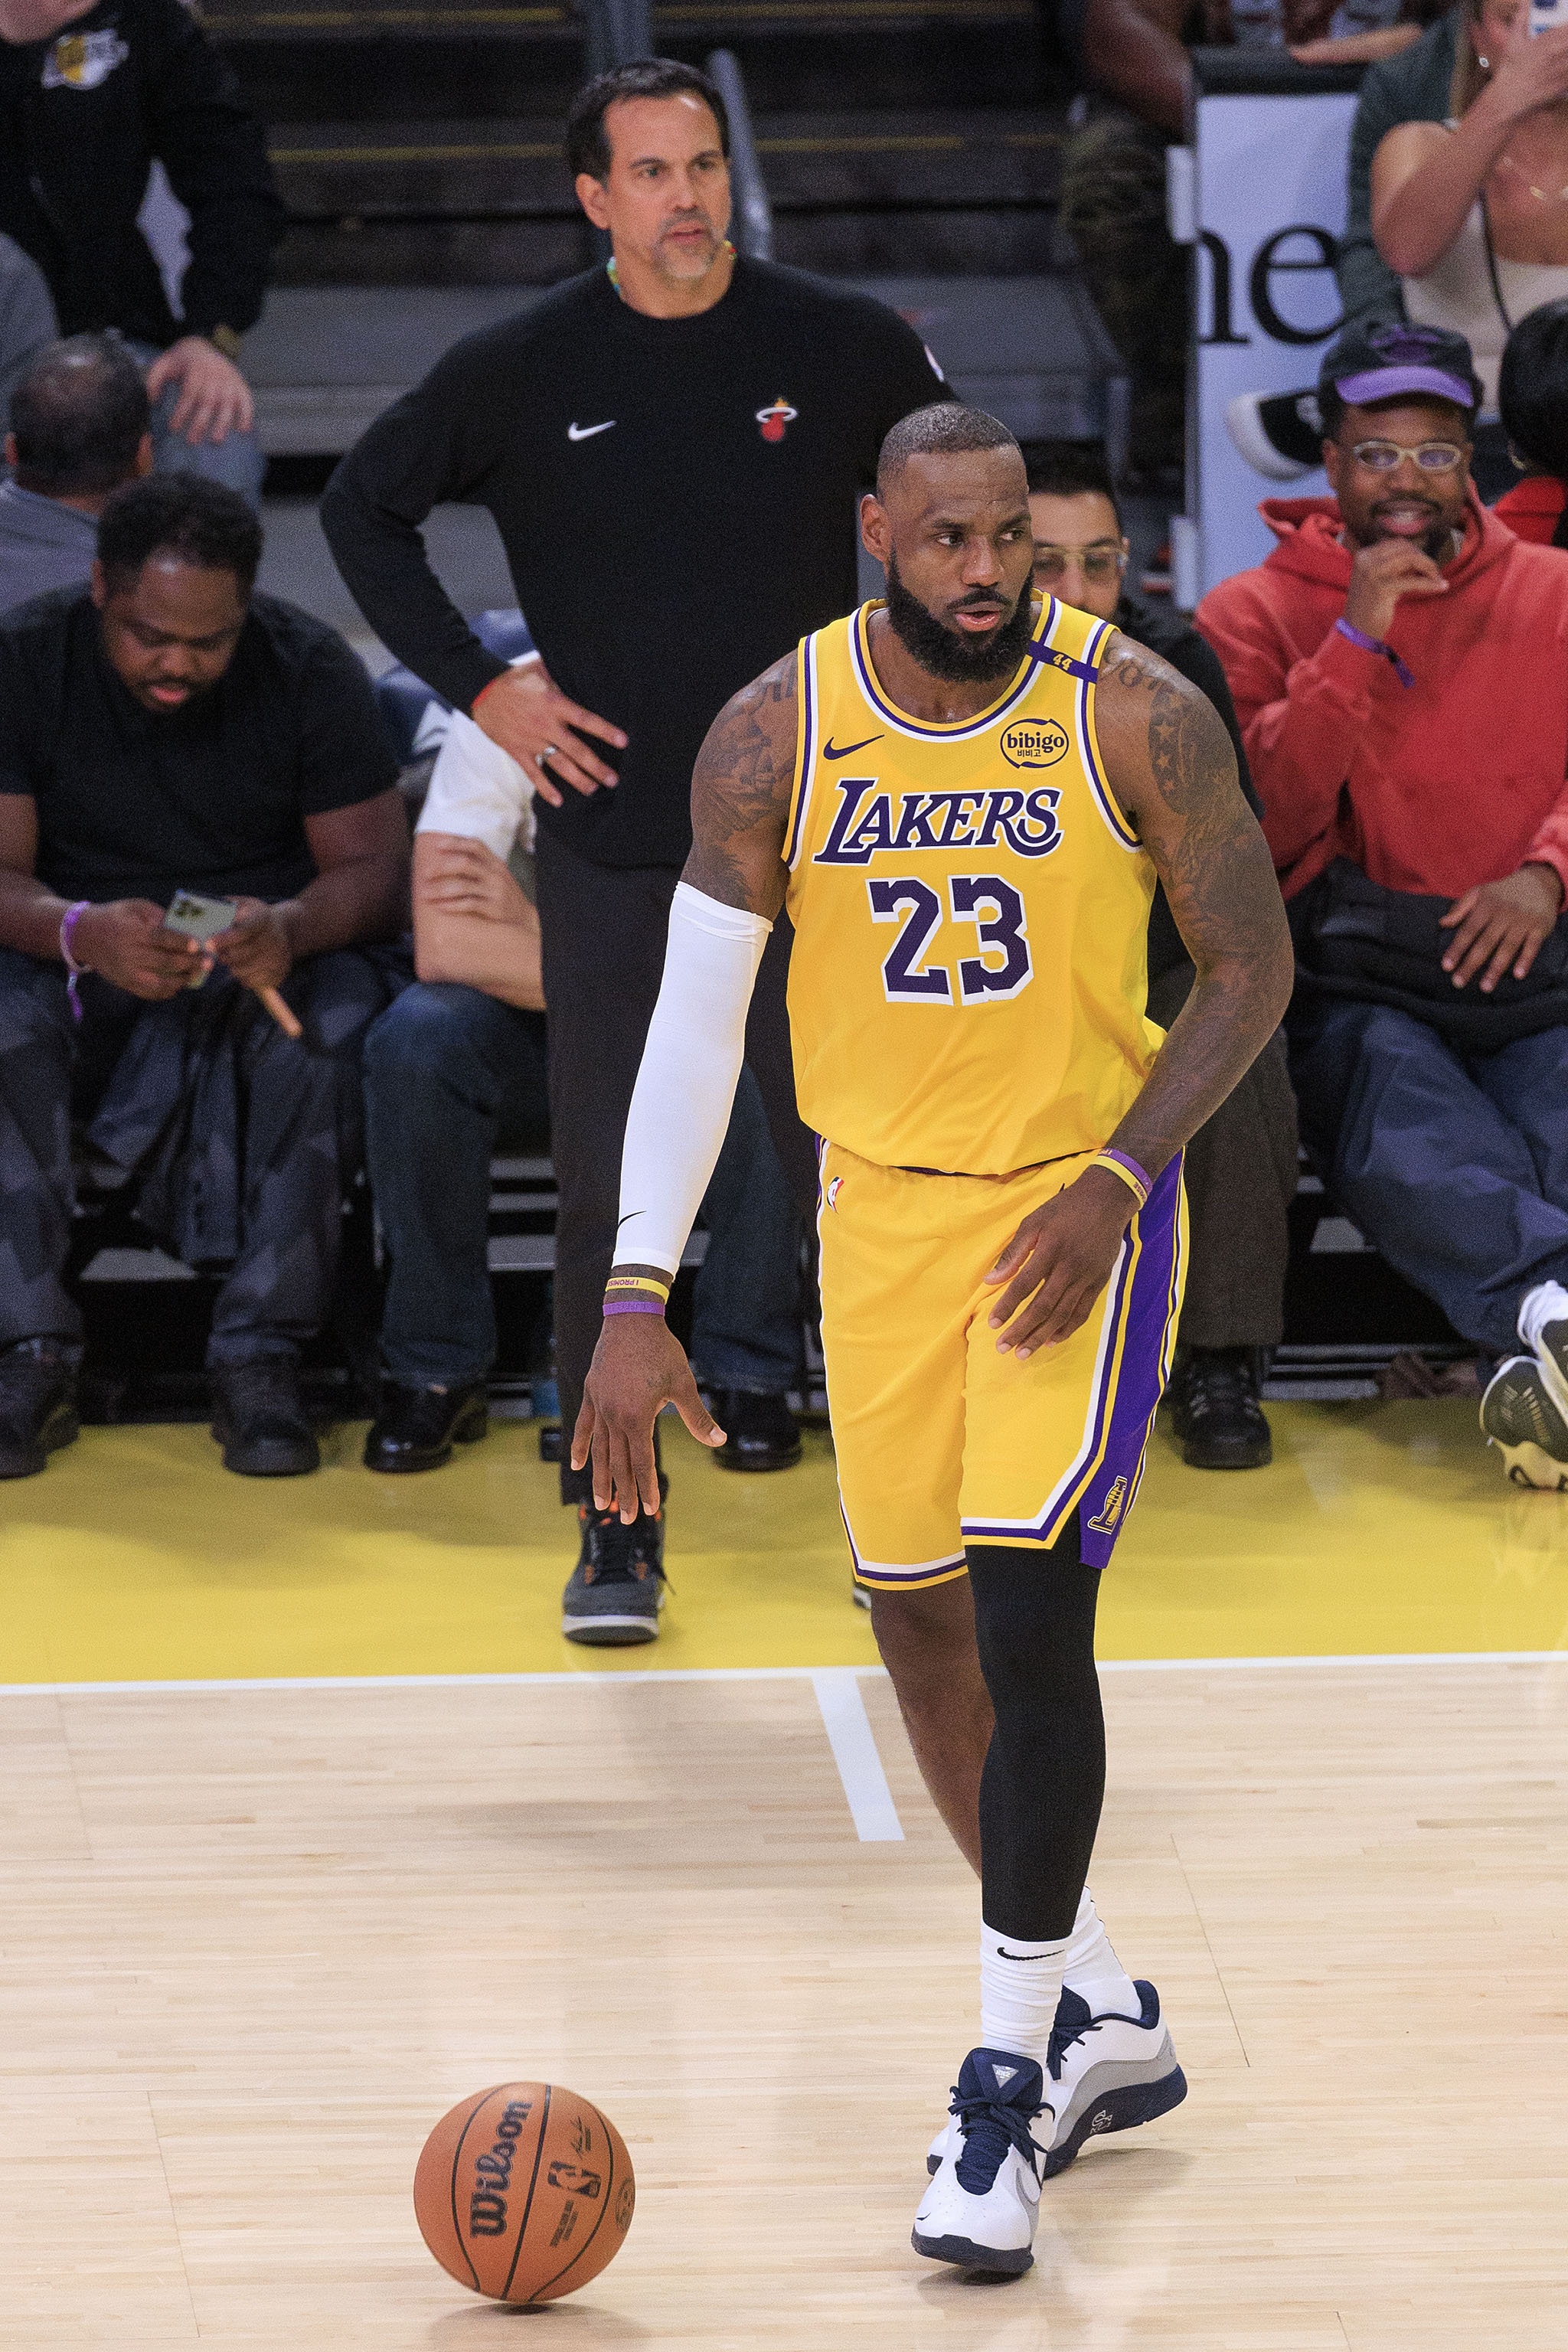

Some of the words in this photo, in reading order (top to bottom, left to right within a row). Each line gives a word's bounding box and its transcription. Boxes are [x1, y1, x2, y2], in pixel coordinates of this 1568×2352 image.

[1053, 654, 1073, 671] 44
[1007, 731, 1064, 753] bibigo
[1017, 749, 1041, 758] 비비고
[812, 776, 1065, 866] LAKERS
[864, 874, 1034, 1006] 23
[469, 2099, 534, 2239] Wilson
